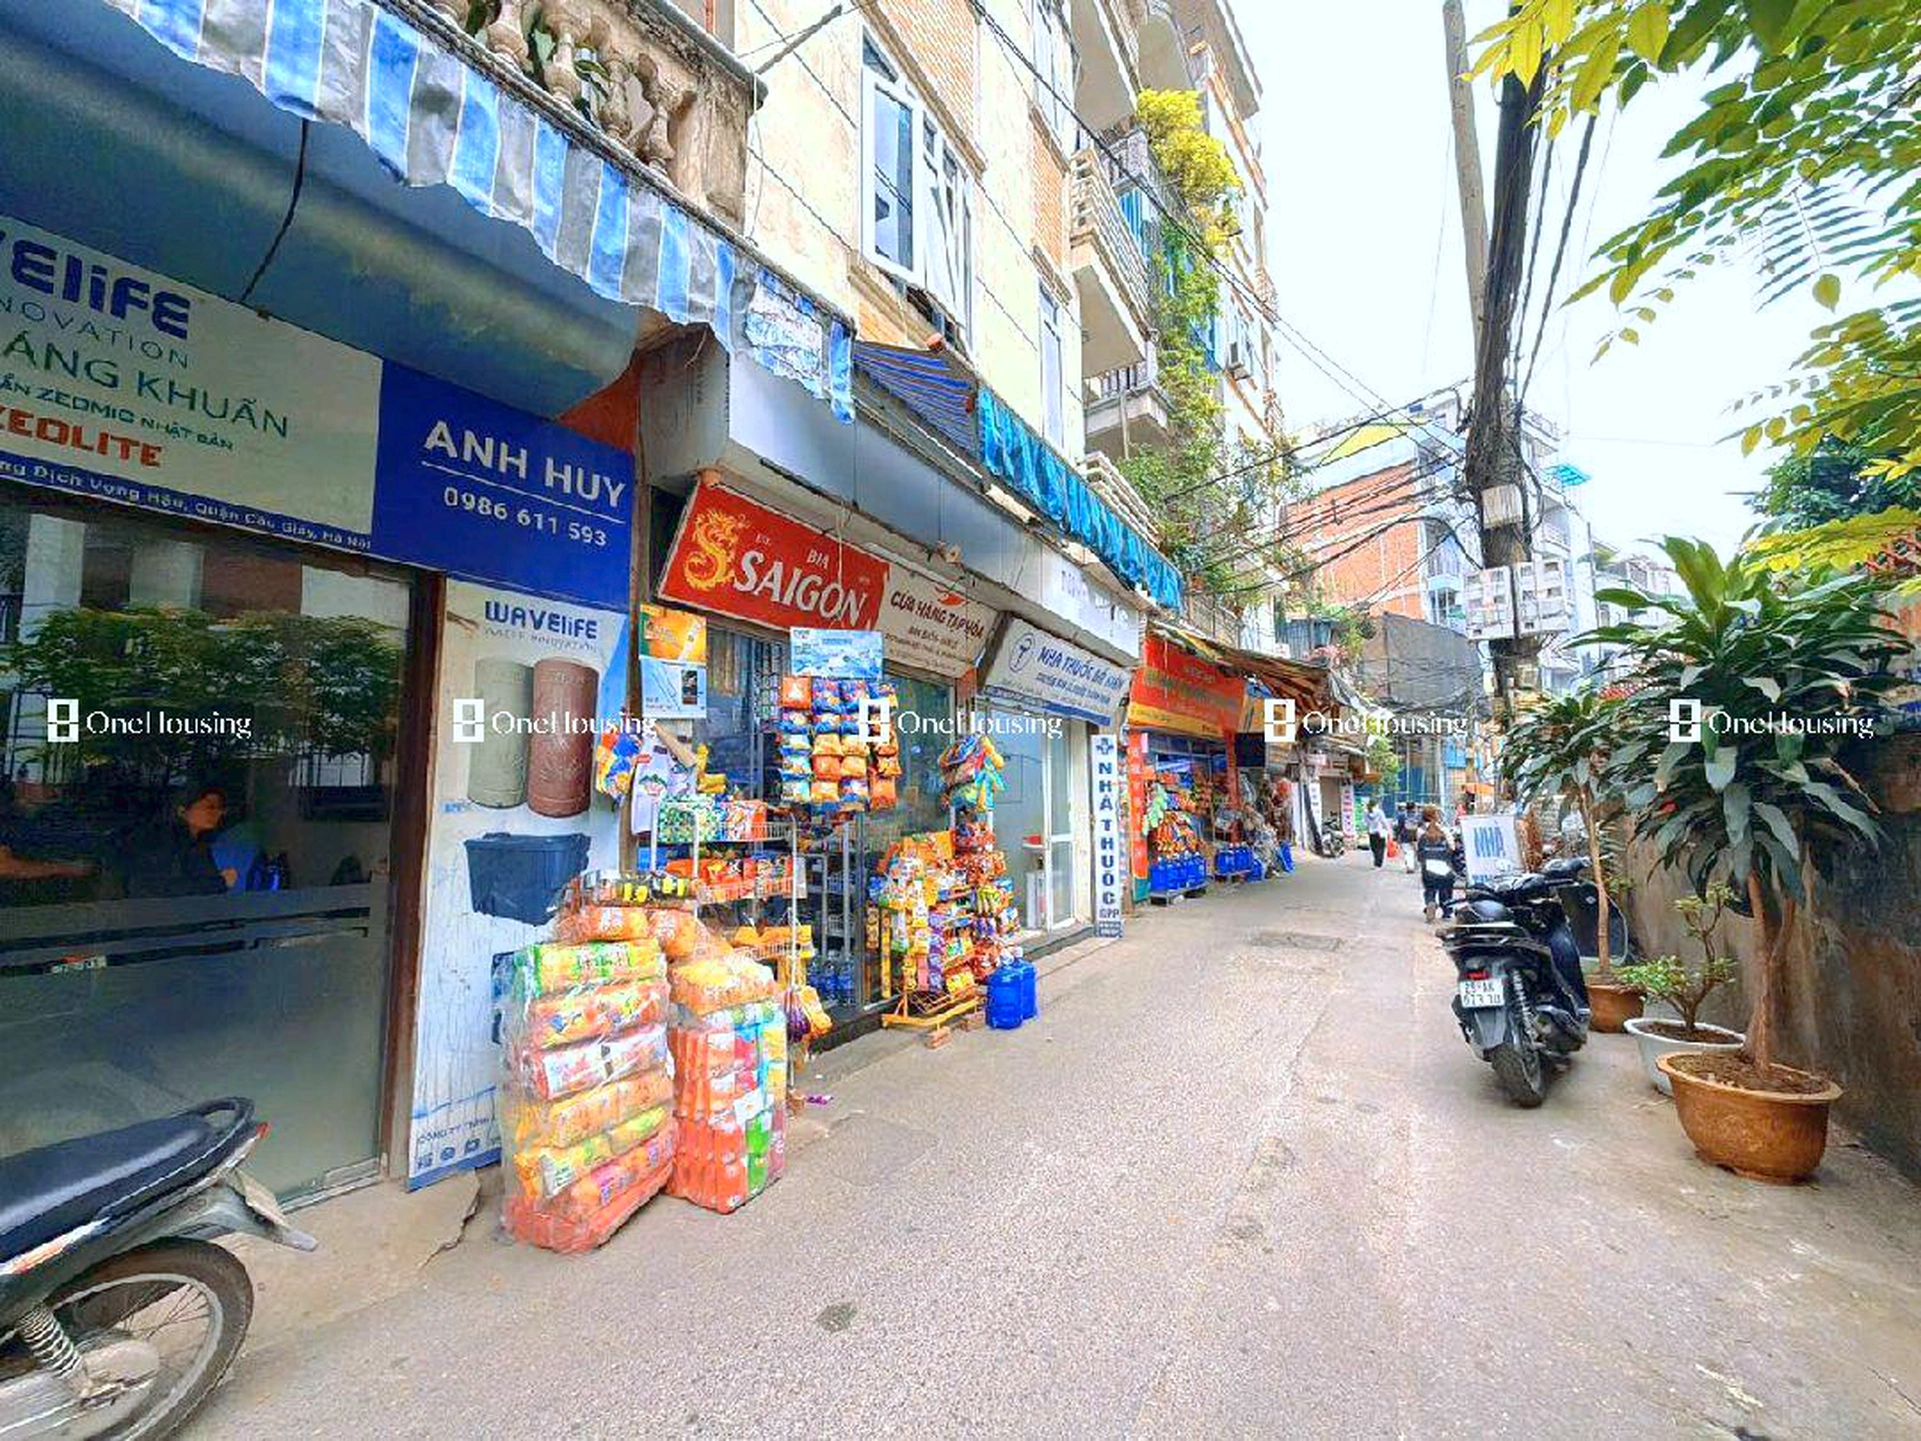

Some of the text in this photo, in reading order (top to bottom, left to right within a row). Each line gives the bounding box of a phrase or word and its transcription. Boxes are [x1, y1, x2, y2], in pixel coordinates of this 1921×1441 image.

[0, 405, 163, 467] EOLITE
[424, 420, 626, 508] ANH HUY
[444, 486, 607, 547] 0986 611 593
[734, 550, 867, 627] SAIGON
[807, 549, 829, 570] BIA
